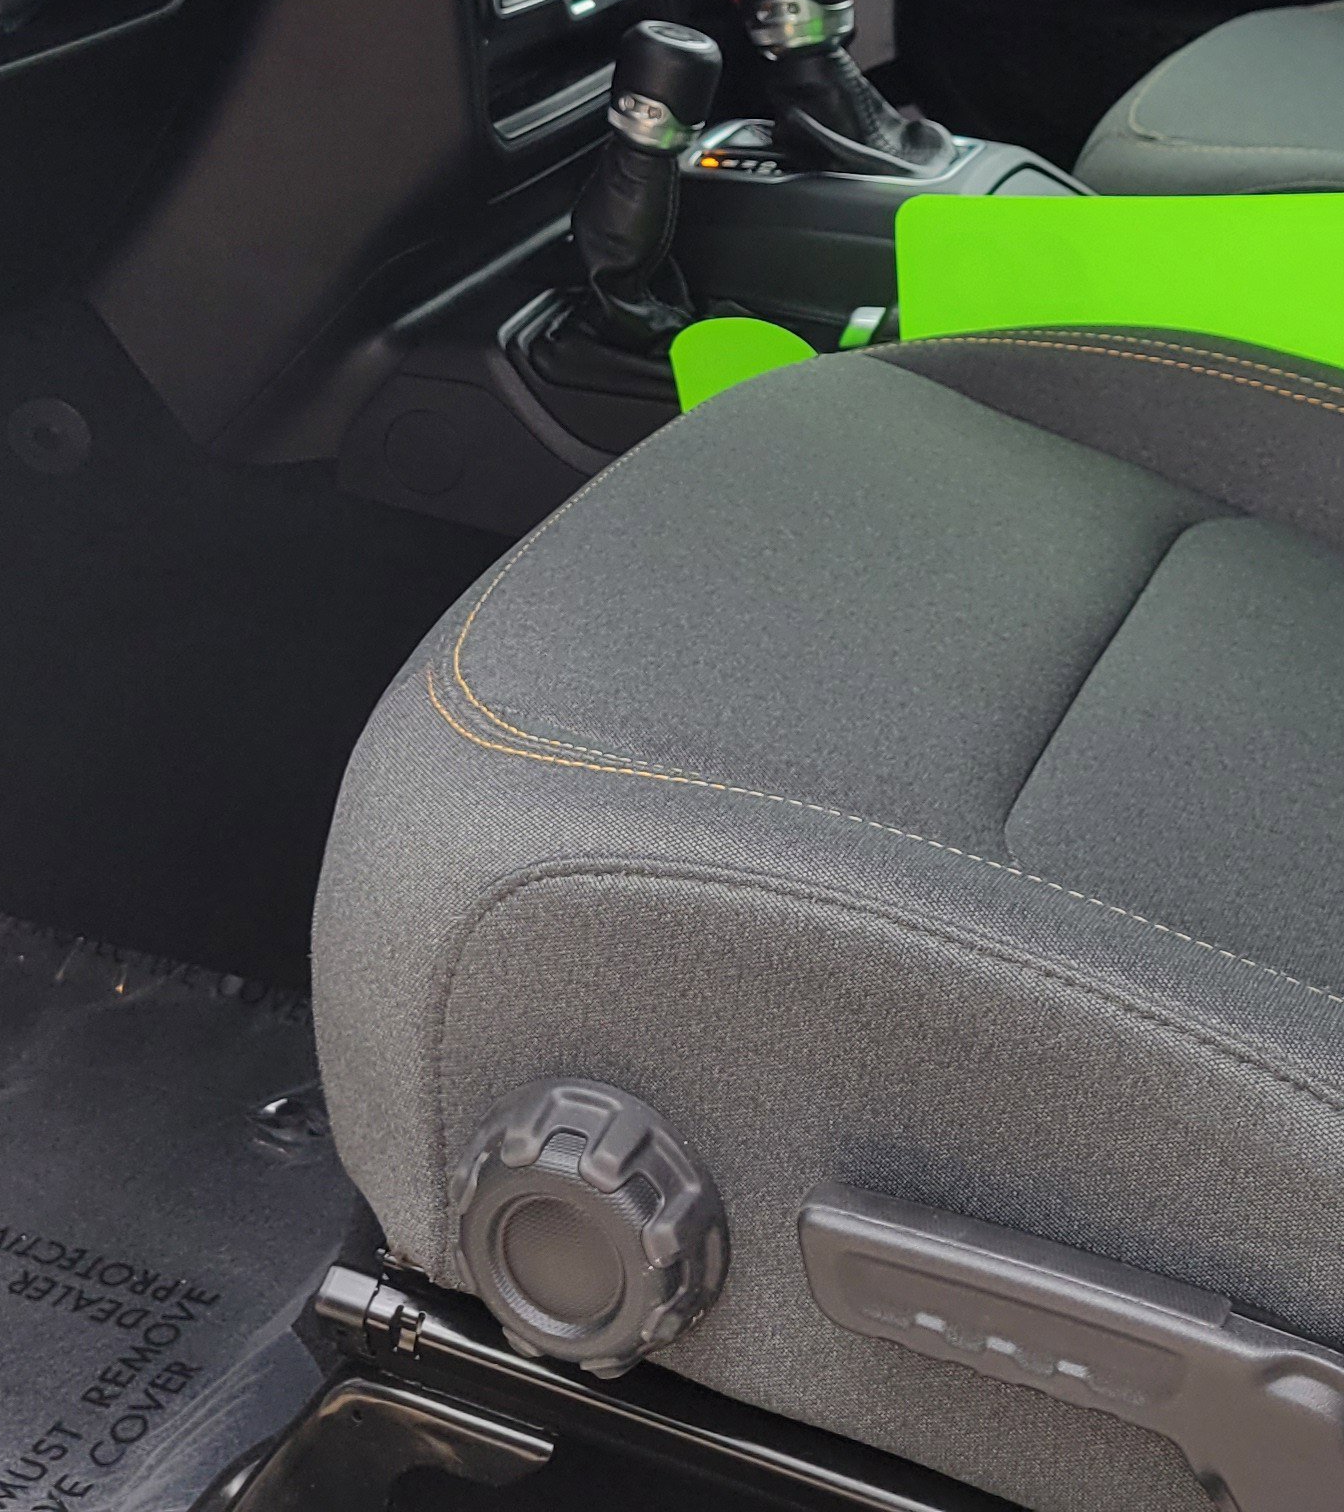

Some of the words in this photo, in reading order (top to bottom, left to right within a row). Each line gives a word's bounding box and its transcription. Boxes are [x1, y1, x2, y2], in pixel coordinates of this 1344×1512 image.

[7, 1269, 152, 1330] DEALER
[79, 1285, 222, 1410] REMOVE
[88, 1359, 205, 1469] COVER
